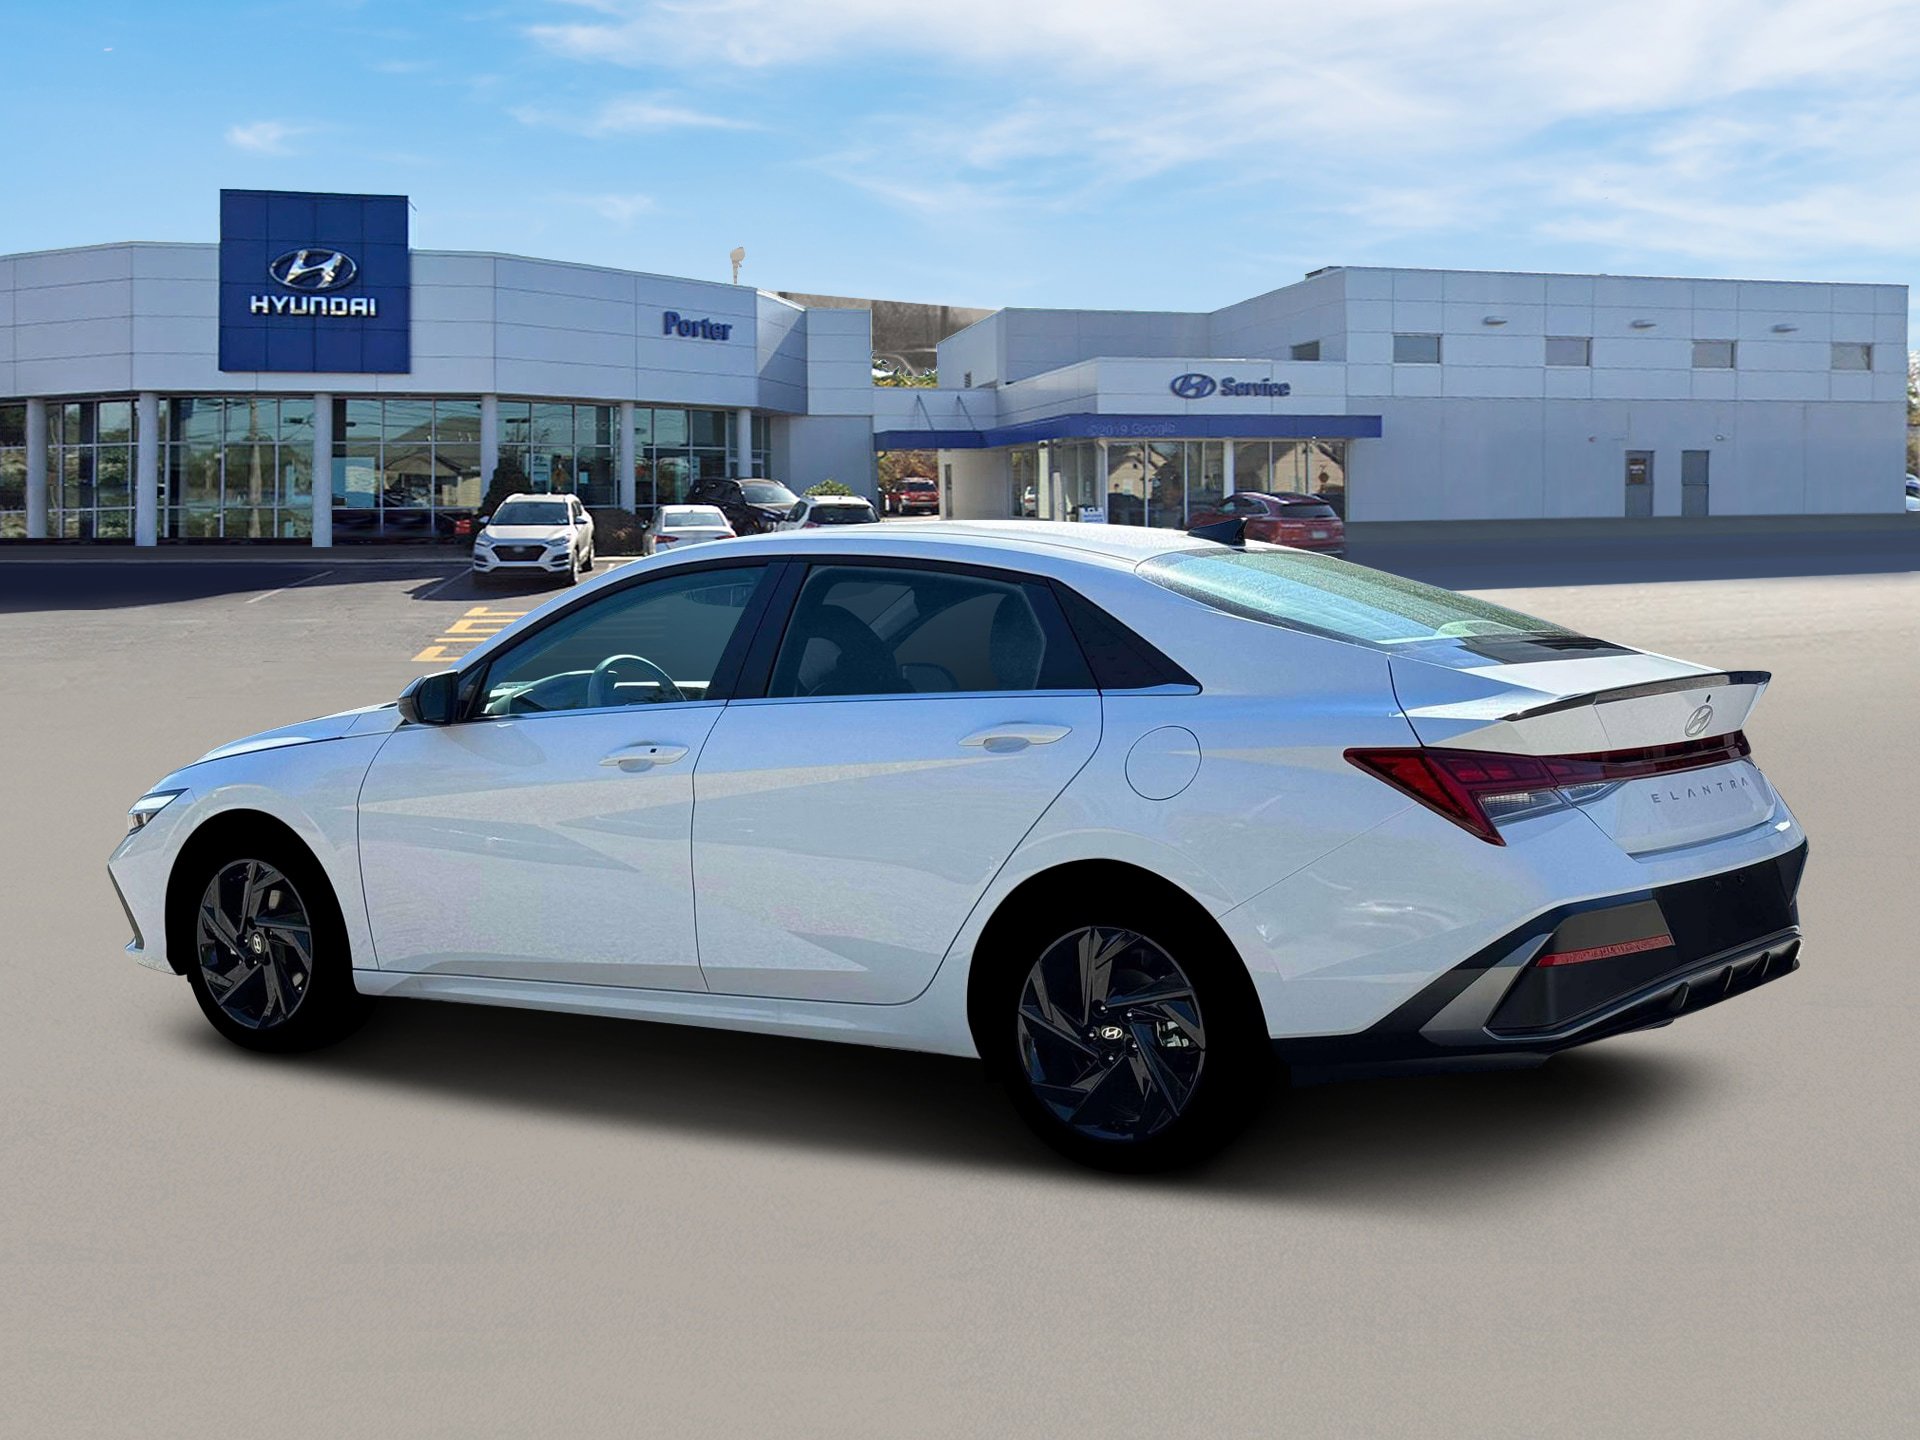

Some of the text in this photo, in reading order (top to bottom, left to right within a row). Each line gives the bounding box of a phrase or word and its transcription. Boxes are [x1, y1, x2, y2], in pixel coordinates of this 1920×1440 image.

[251, 295, 377, 317] HYUNDAI
[663, 310, 733, 341] Porter
[1221, 377, 1291, 396] Service
[1652, 778, 1748, 803] ELANTRA
